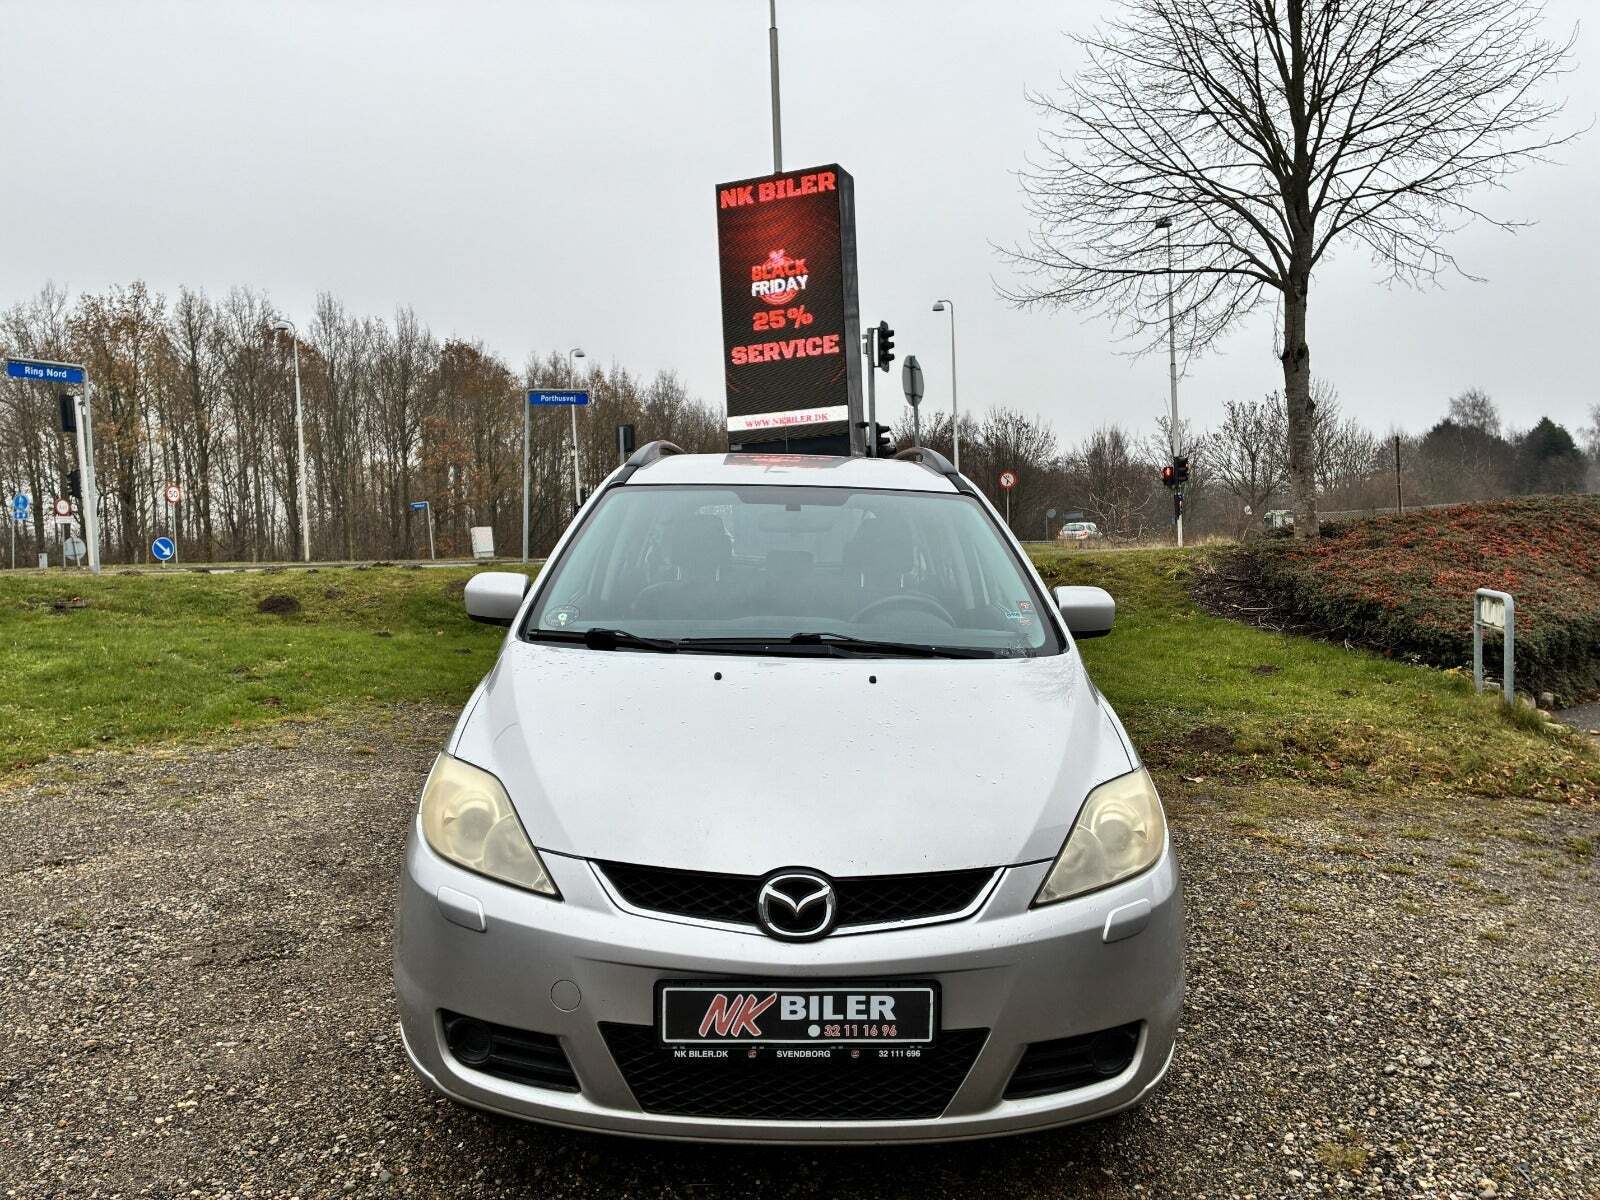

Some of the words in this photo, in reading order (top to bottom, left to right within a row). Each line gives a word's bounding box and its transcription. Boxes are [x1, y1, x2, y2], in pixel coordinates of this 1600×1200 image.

[720, 186, 754, 208] NK
[758, 171, 836, 202] BILER
[751, 258, 808, 281] BLACK
[751, 274, 808, 297] FRIDAY
[731, 334, 840, 366] SERVICE
[24, 366, 44, 377] Ring
[46, 368, 67, 378] Nord
[540, 394, 576, 403] Porthusvej
[698, 992, 778, 1038] NK
[780, 995, 897, 1021] BILER
[823, 1024, 841, 1037] 32
[844, 1024, 858, 1037] 11
[863, 1024, 879, 1037] 16
[881, 1024, 898, 1037] 96
[674, 1050, 687, 1058] NK
[688, 1050, 729, 1058] BILER.DK
[776, 1050, 831, 1058] SVENDBORG
[878, 1050, 889, 1058] 32
[890, 1050, 904, 1058] 111
[906, 1050, 921, 1058] 696
